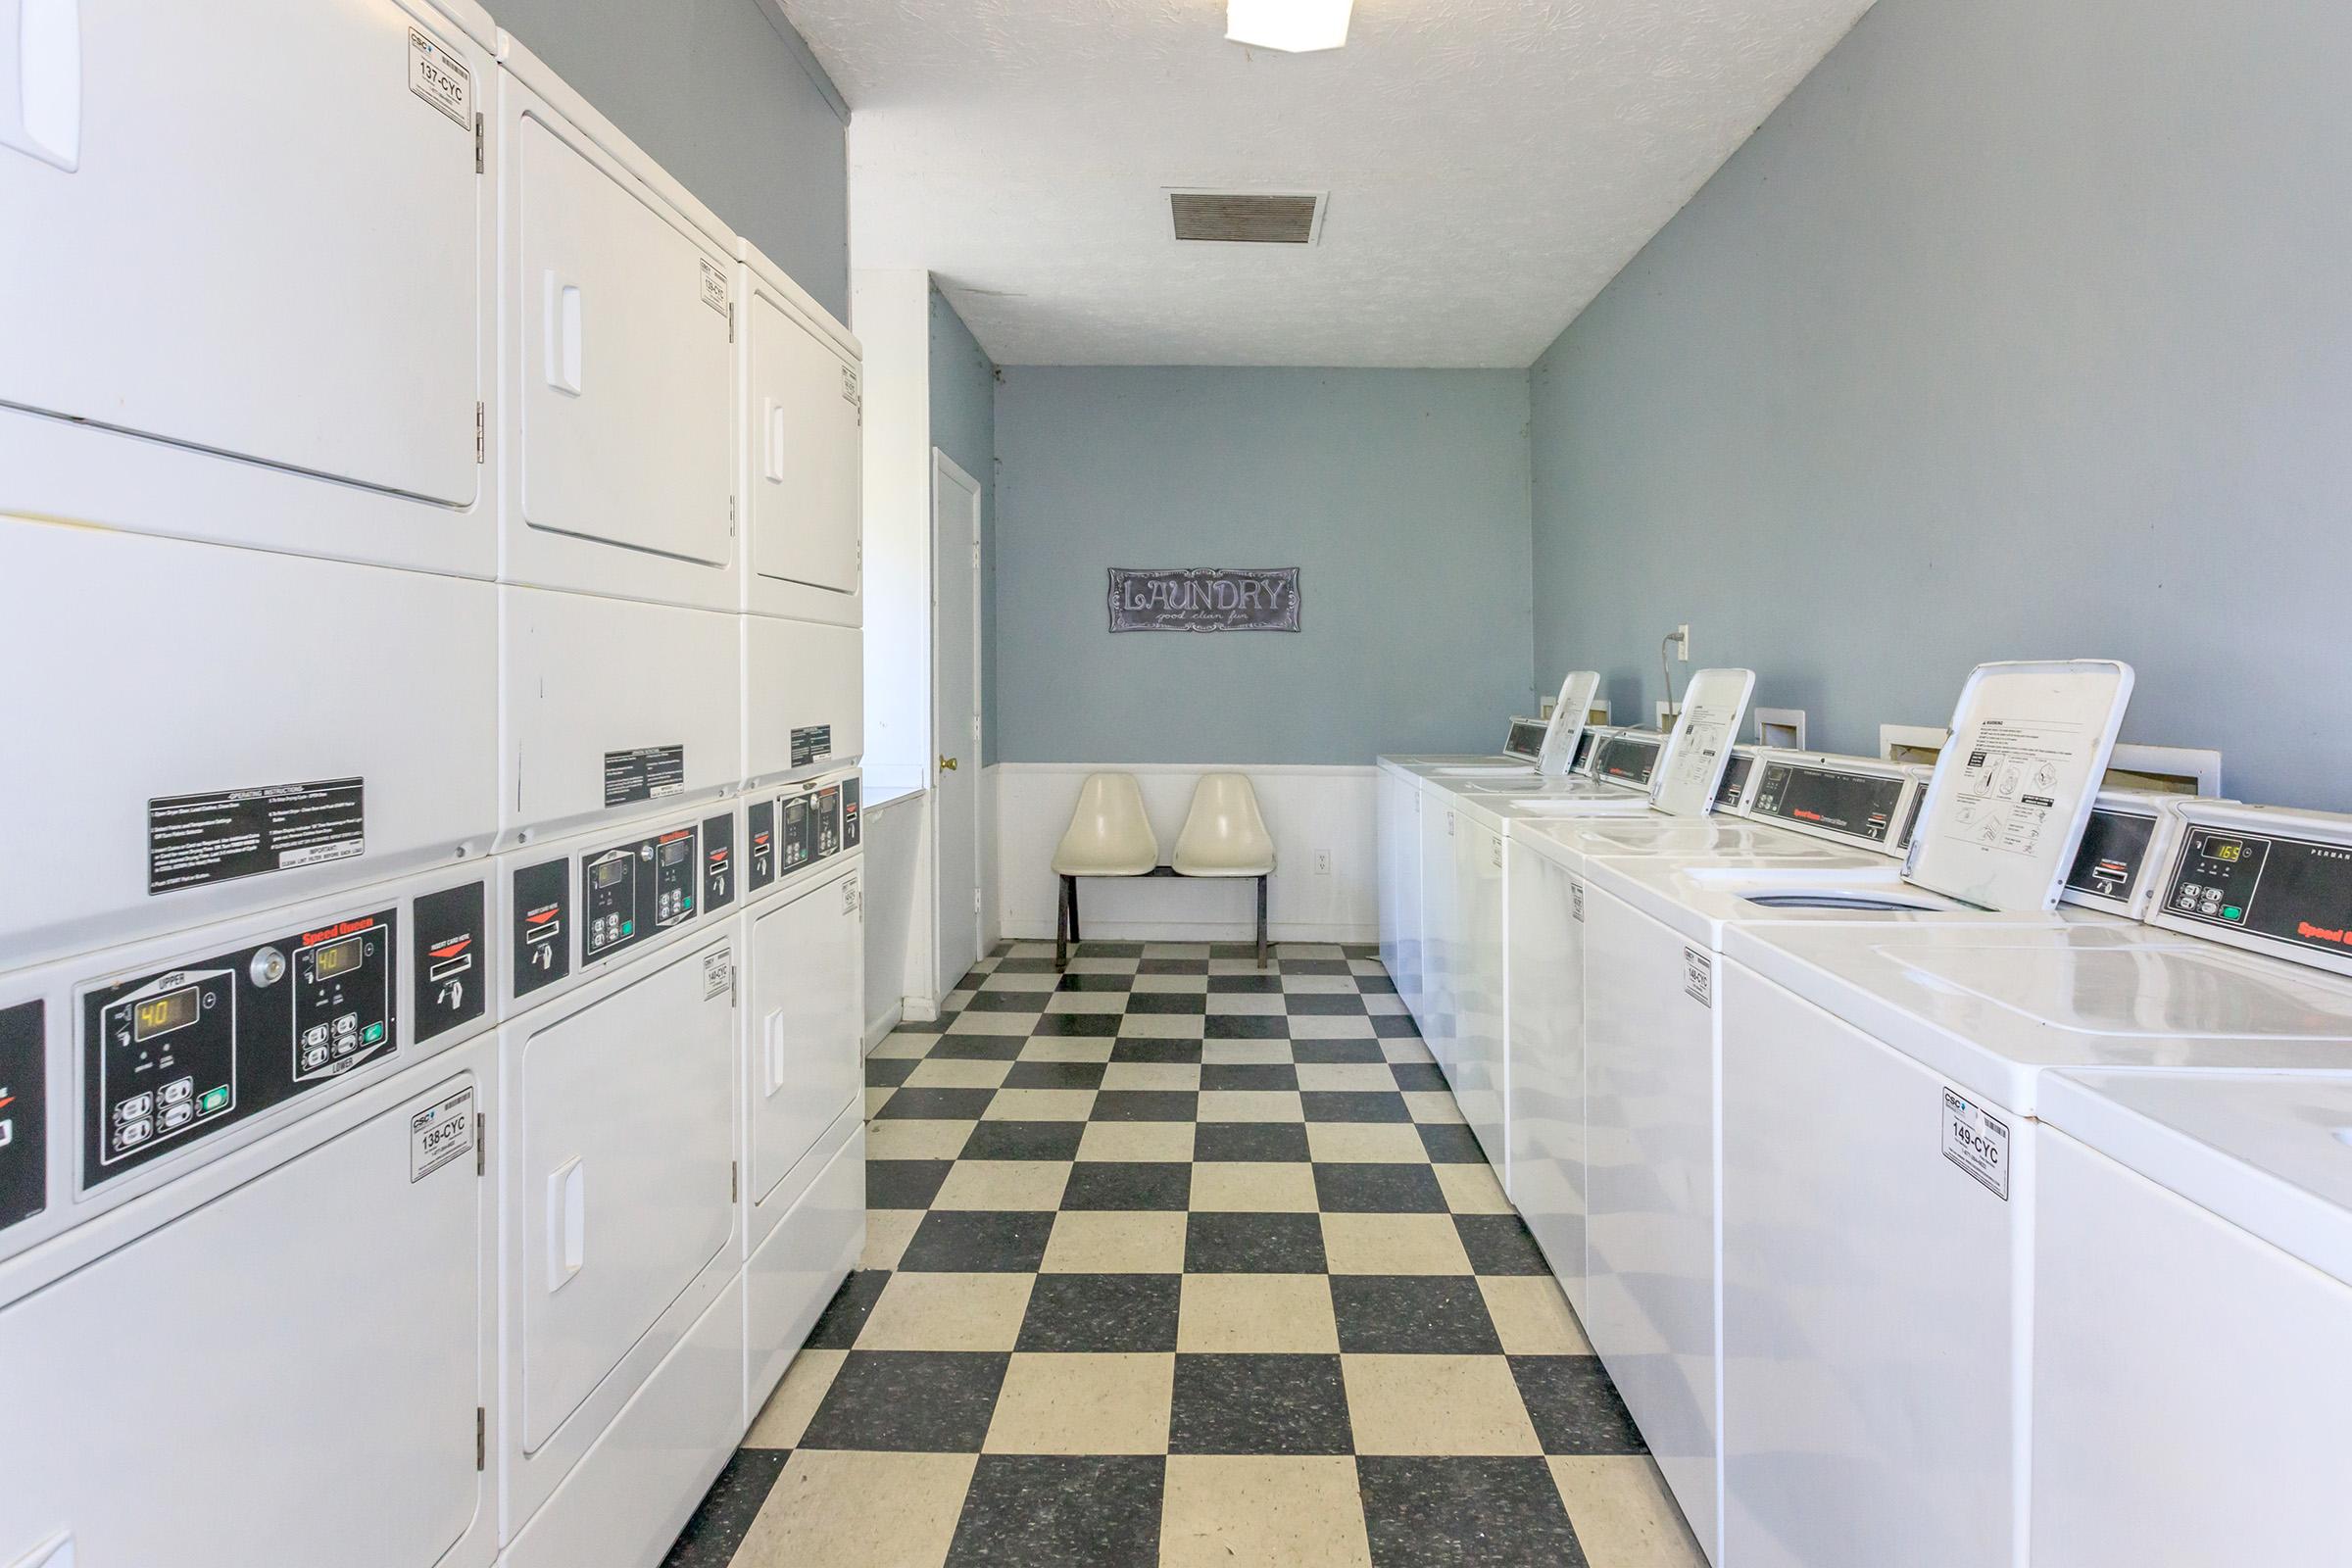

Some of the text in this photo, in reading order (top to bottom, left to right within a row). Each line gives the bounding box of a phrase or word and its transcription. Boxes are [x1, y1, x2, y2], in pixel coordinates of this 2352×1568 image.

[420, 62, 463, 101] 137-CYC
[1123, 579, 1286, 611] LAUNDRY
[1155, 610, 1249, 624] good clean fun
[302, 916, 374, 947] Speed Queen
[318, 949, 337, 971] 40
[159, 973, 185, 990] UPPER
[140, 1000, 169, 1027] 40
[332, 1056, 354, 1074] LOWER
[1944, 1093, 1961, 1108] CSC
[413, 1114, 429, 1128] CSC
[422, 1116, 466, 1150] 138-CYC
[1953, 1121, 1998, 1164] 149-CYC
